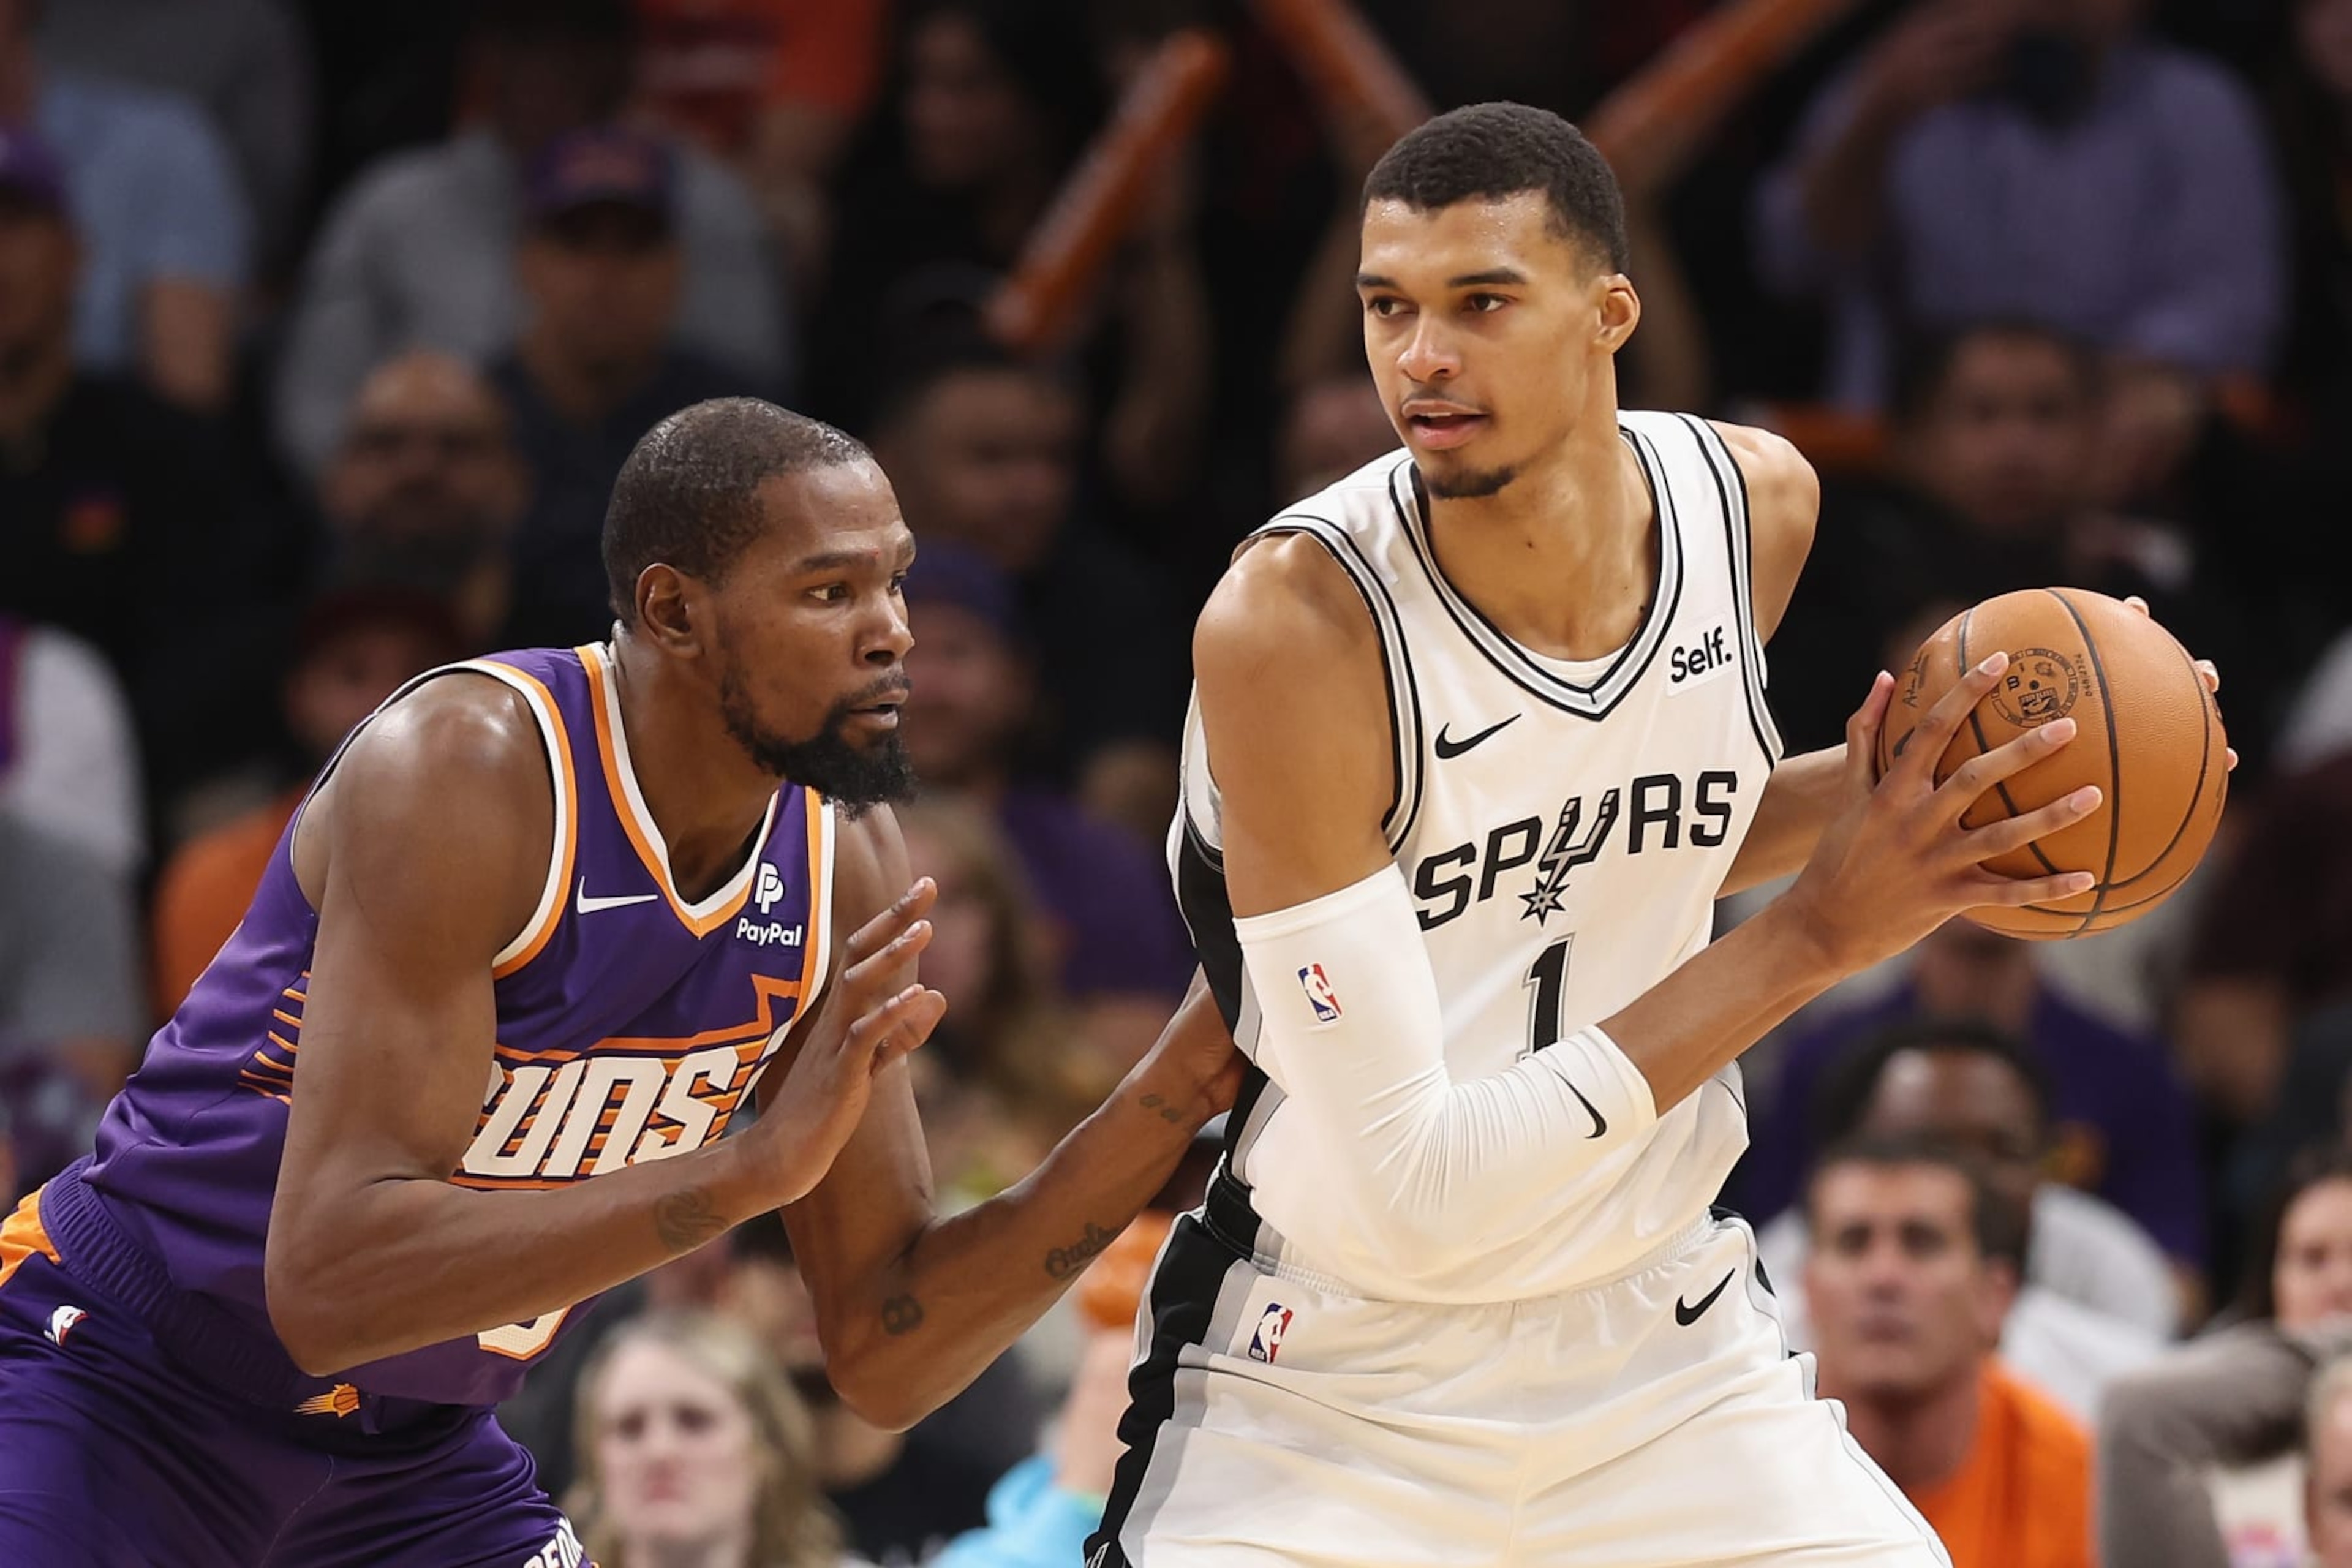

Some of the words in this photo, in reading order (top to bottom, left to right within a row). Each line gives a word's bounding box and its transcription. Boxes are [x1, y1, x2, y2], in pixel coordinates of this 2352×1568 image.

[1671, 625, 1732, 683] Self.
[1414, 771, 1737, 932] SPURS
[736, 917, 802, 946] PayPal
[1516, 932, 1577, 1063] 1
[462, 1046, 739, 1177] UNS
